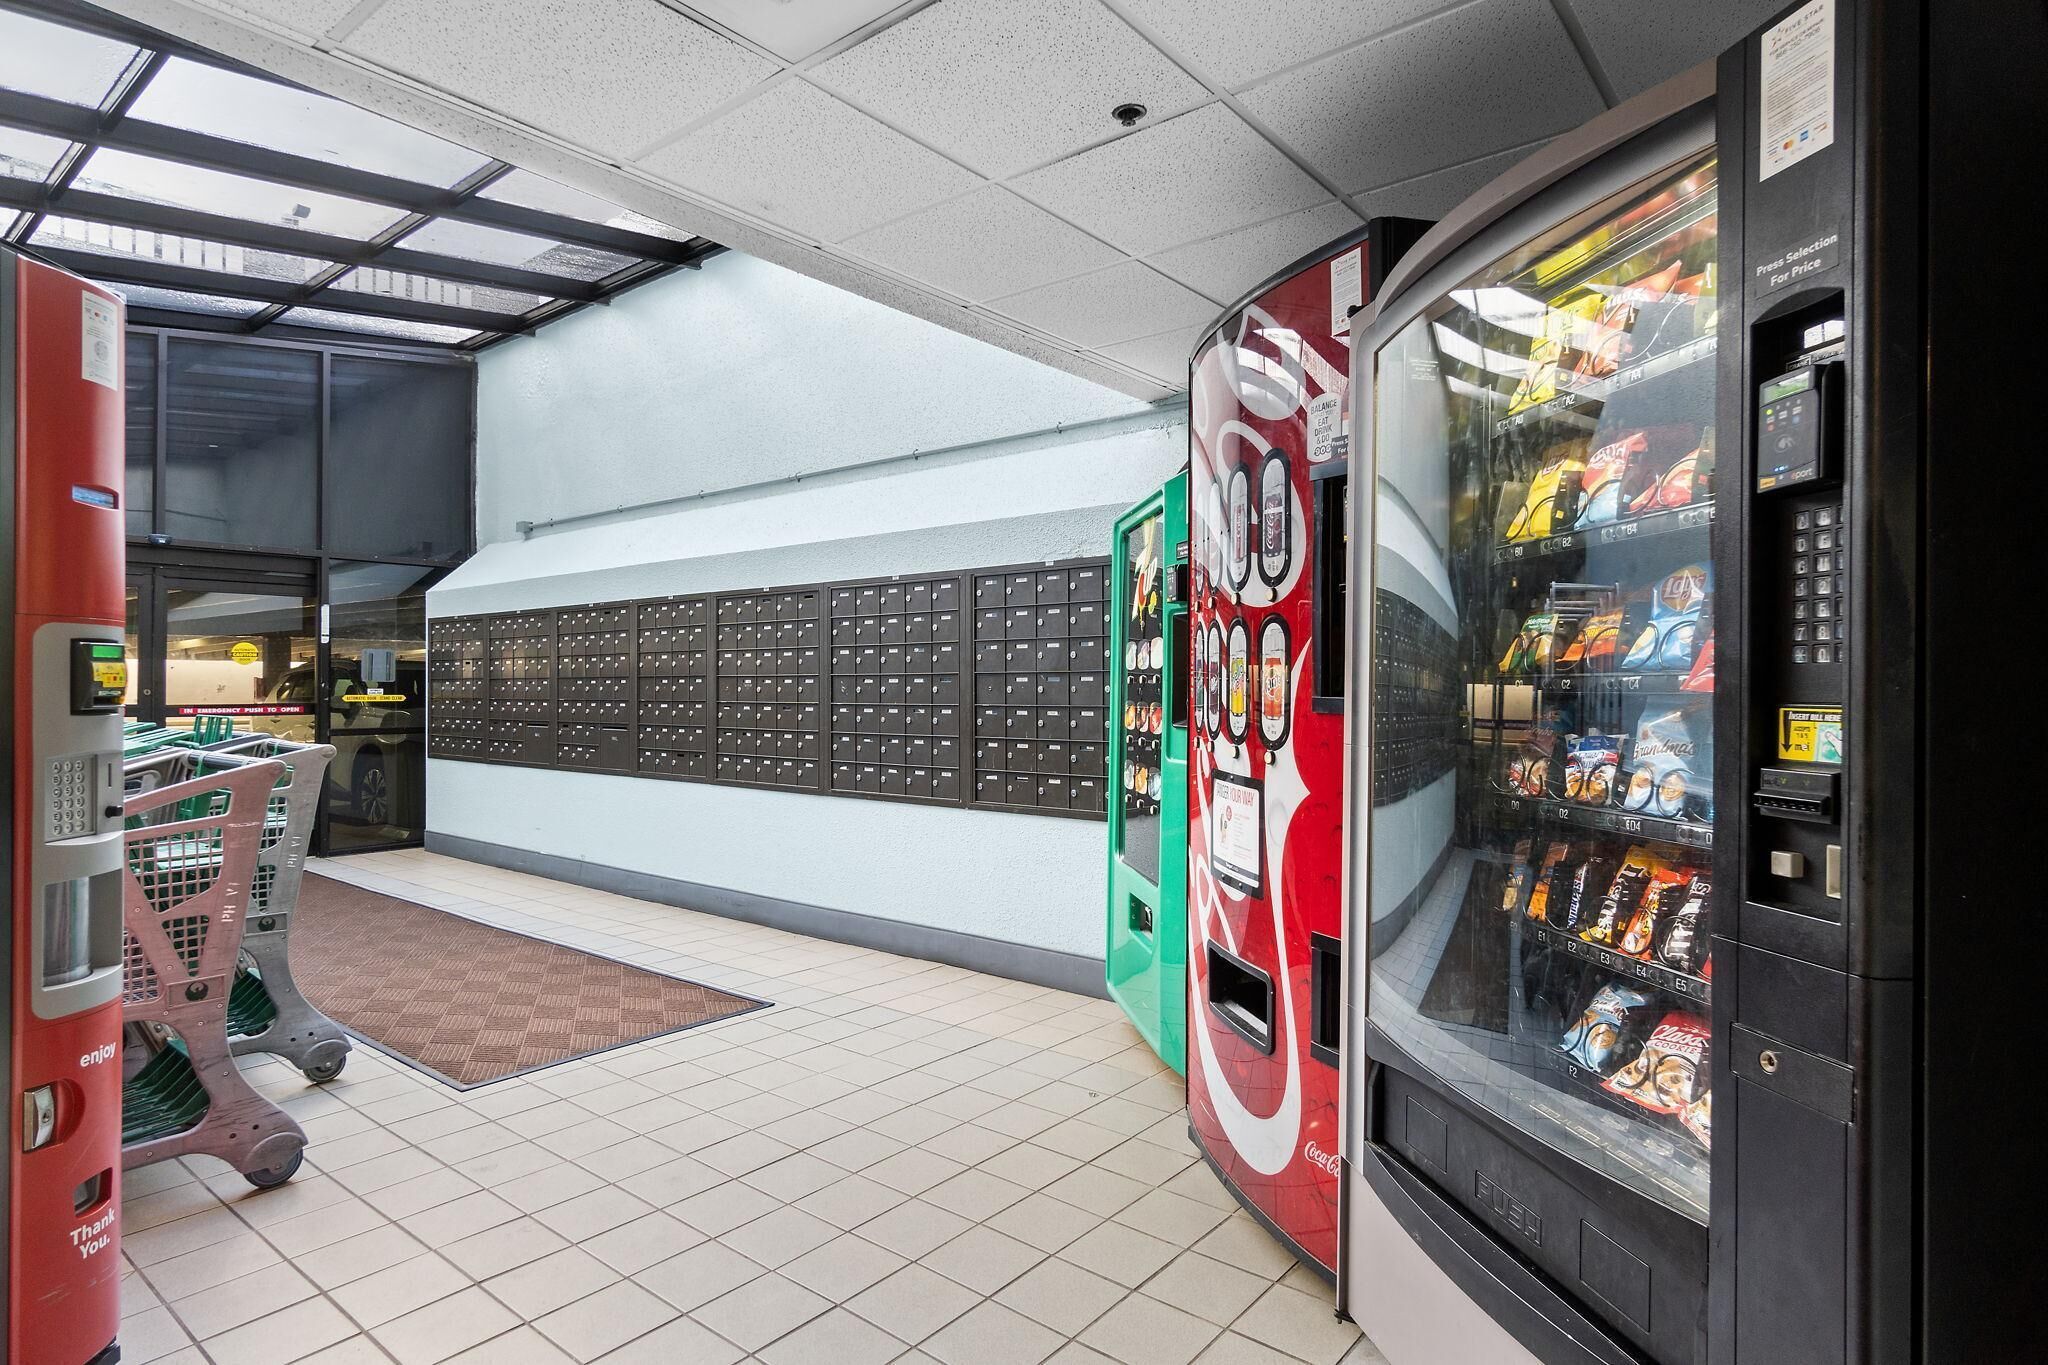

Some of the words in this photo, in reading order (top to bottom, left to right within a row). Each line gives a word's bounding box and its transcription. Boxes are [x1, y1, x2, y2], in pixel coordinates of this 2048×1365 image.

[1756, 258, 1784, 276] Press
[1786, 234, 1838, 263] Selection
[1770, 271, 1790, 286] For
[1791, 258, 1822, 277] Price
[1311, 399, 1337, 415] BALANCE
[1318, 417, 1328, 426] EAT
[1315, 425, 1332, 436] DRINK
[1561, 679, 1571, 690] C2
[1629, 679, 1640, 690] C4
[1788, 711, 1810, 720] INSERT
[1810, 713, 1824, 721] BILL
[1824, 714, 1842, 722] HERE
[1538, 930, 1546, 941] E1
[1567, 941, 1577, 952] E2
[1600, 953, 1610, 964] E3
[1636, 965, 1647, 977] E4
[1675, 978, 1687, 991] E5
[80, 1041, 116, 1067] enjoy
[1569, 1065, 1578, 1077] F2
[1478, 1177, 1540, 1245] PUSH
[70, 1207, 115, 1246] Thank
[79, 1234, 111, 1260] You.
